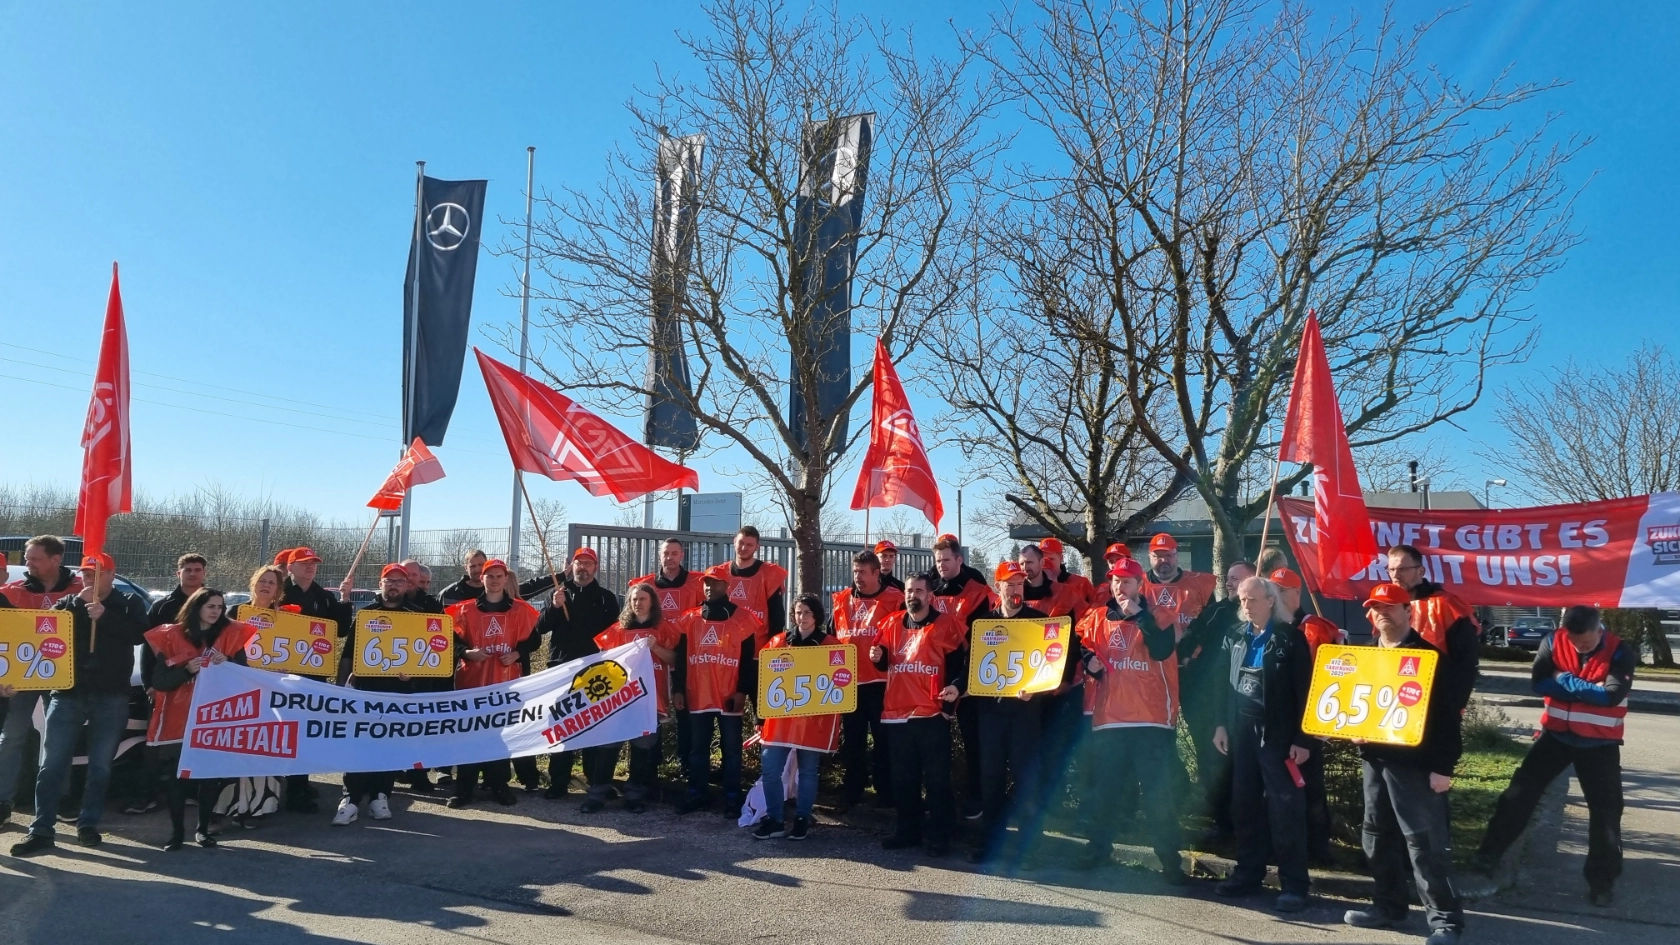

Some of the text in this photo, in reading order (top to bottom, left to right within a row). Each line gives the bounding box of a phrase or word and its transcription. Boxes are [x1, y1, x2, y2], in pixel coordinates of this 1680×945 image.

[1455, 523, 1550, 550] GIBT
[1558, 519, 1610, 549] ES
[1650, 526, 1680, 540] ZUK
[1653, 540, 1680, 554] SIC
[1476, 554, 1573, 587] UNS!
[15, 641, 57, 680] %
[294, 639, 324, 668] %
[363, 636, 441, 672] 6,5 %
[698, 653, 739, 667] streiken
[894, 661, 939, 675] streiken
[978, 648, 1054, 691] 6,5 %
[200, 696, 254, 721] TEAM
[270, 690, 521, 715] DRUCK MACHEN FÜR
[549, 691, 588, 721] KFZ
[767, 673, 845, 713] 6,5 %
[1317, 682, 1410, 730] 6,5 %
[306, 704, 544, 739] DIE FORDERUNGEN!
[541, 678, 643, 746] TARIFRUNDE
[196, 724, 292, 755] IG METALL
